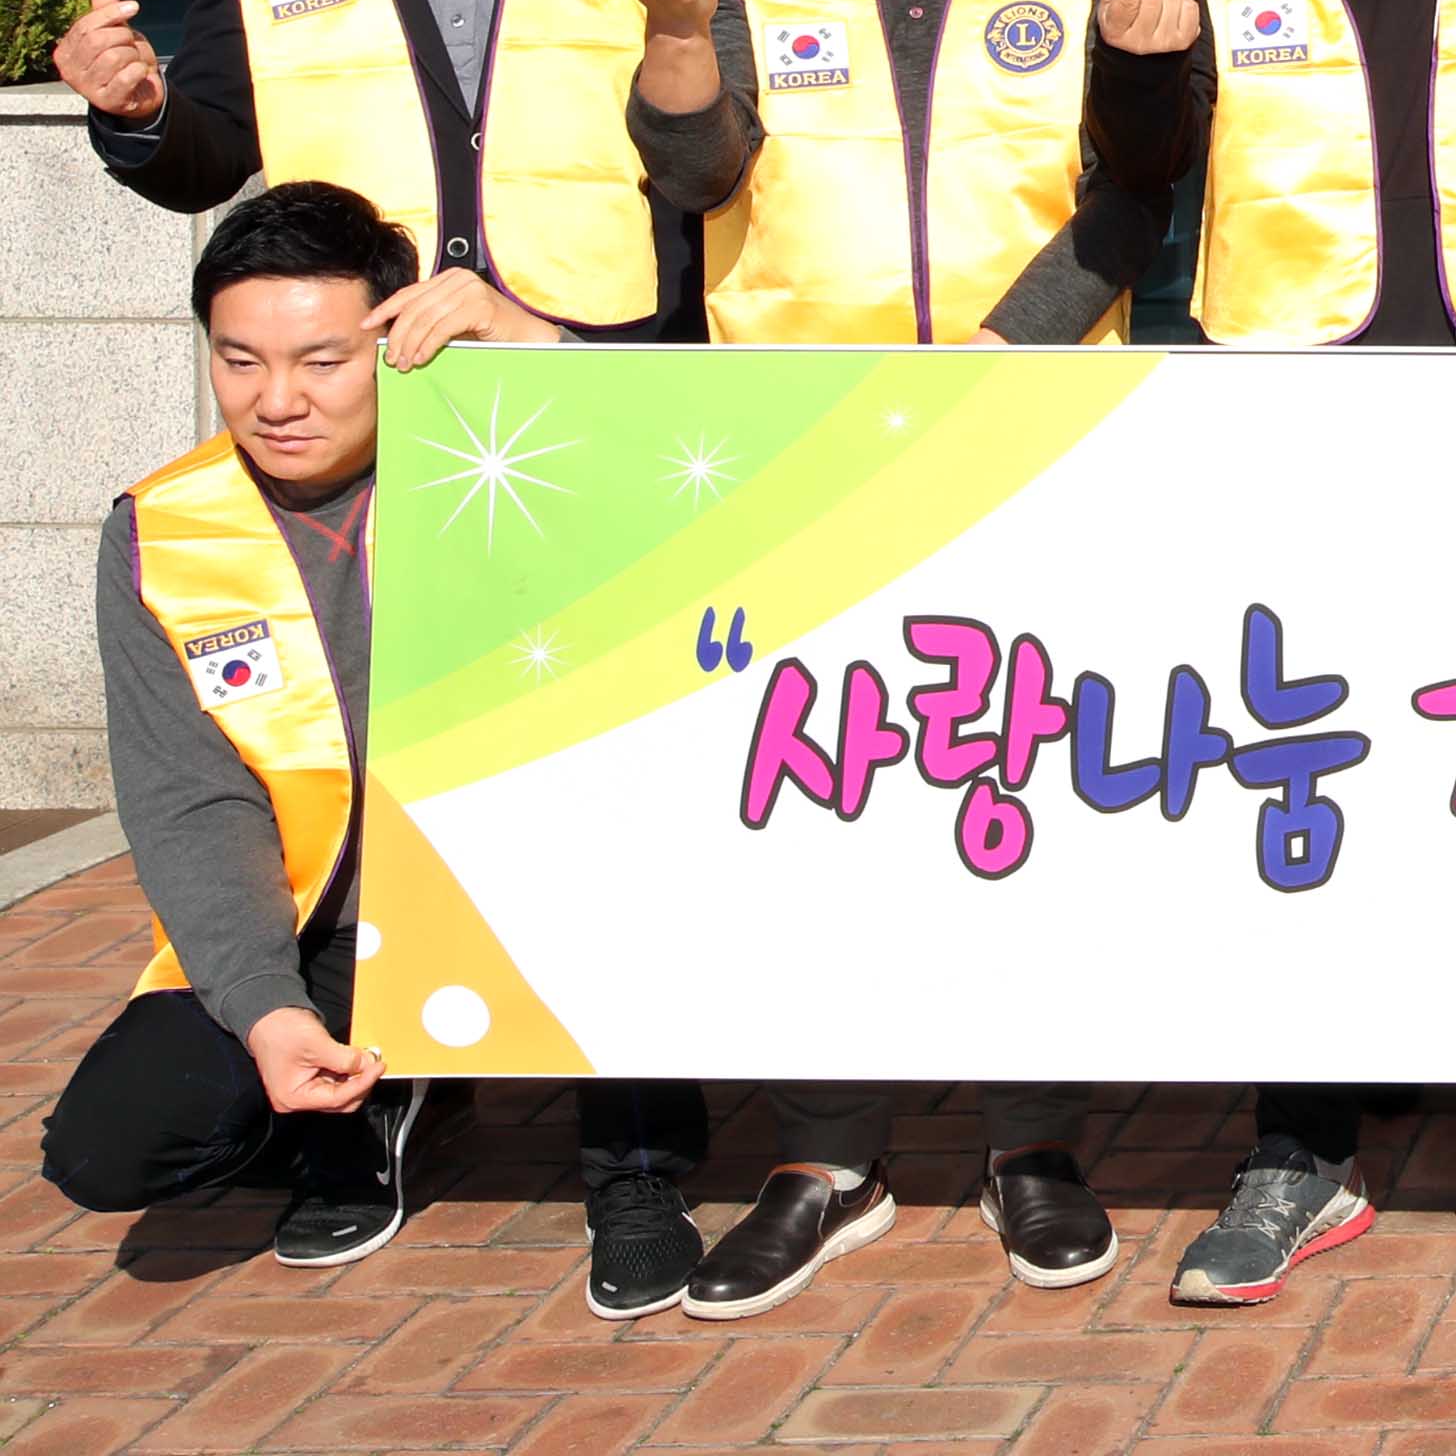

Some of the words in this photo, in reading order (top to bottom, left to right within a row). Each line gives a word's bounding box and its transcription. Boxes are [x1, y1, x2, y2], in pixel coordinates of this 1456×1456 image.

[1003, 6, 1046, 20] LIONS
[1015, 23, 1036, 46] L
[1236, 46, 1307, 65] KOREA
[774, 71, 846, 88] KOREA
[187, 622, 265, 657] KOREA
